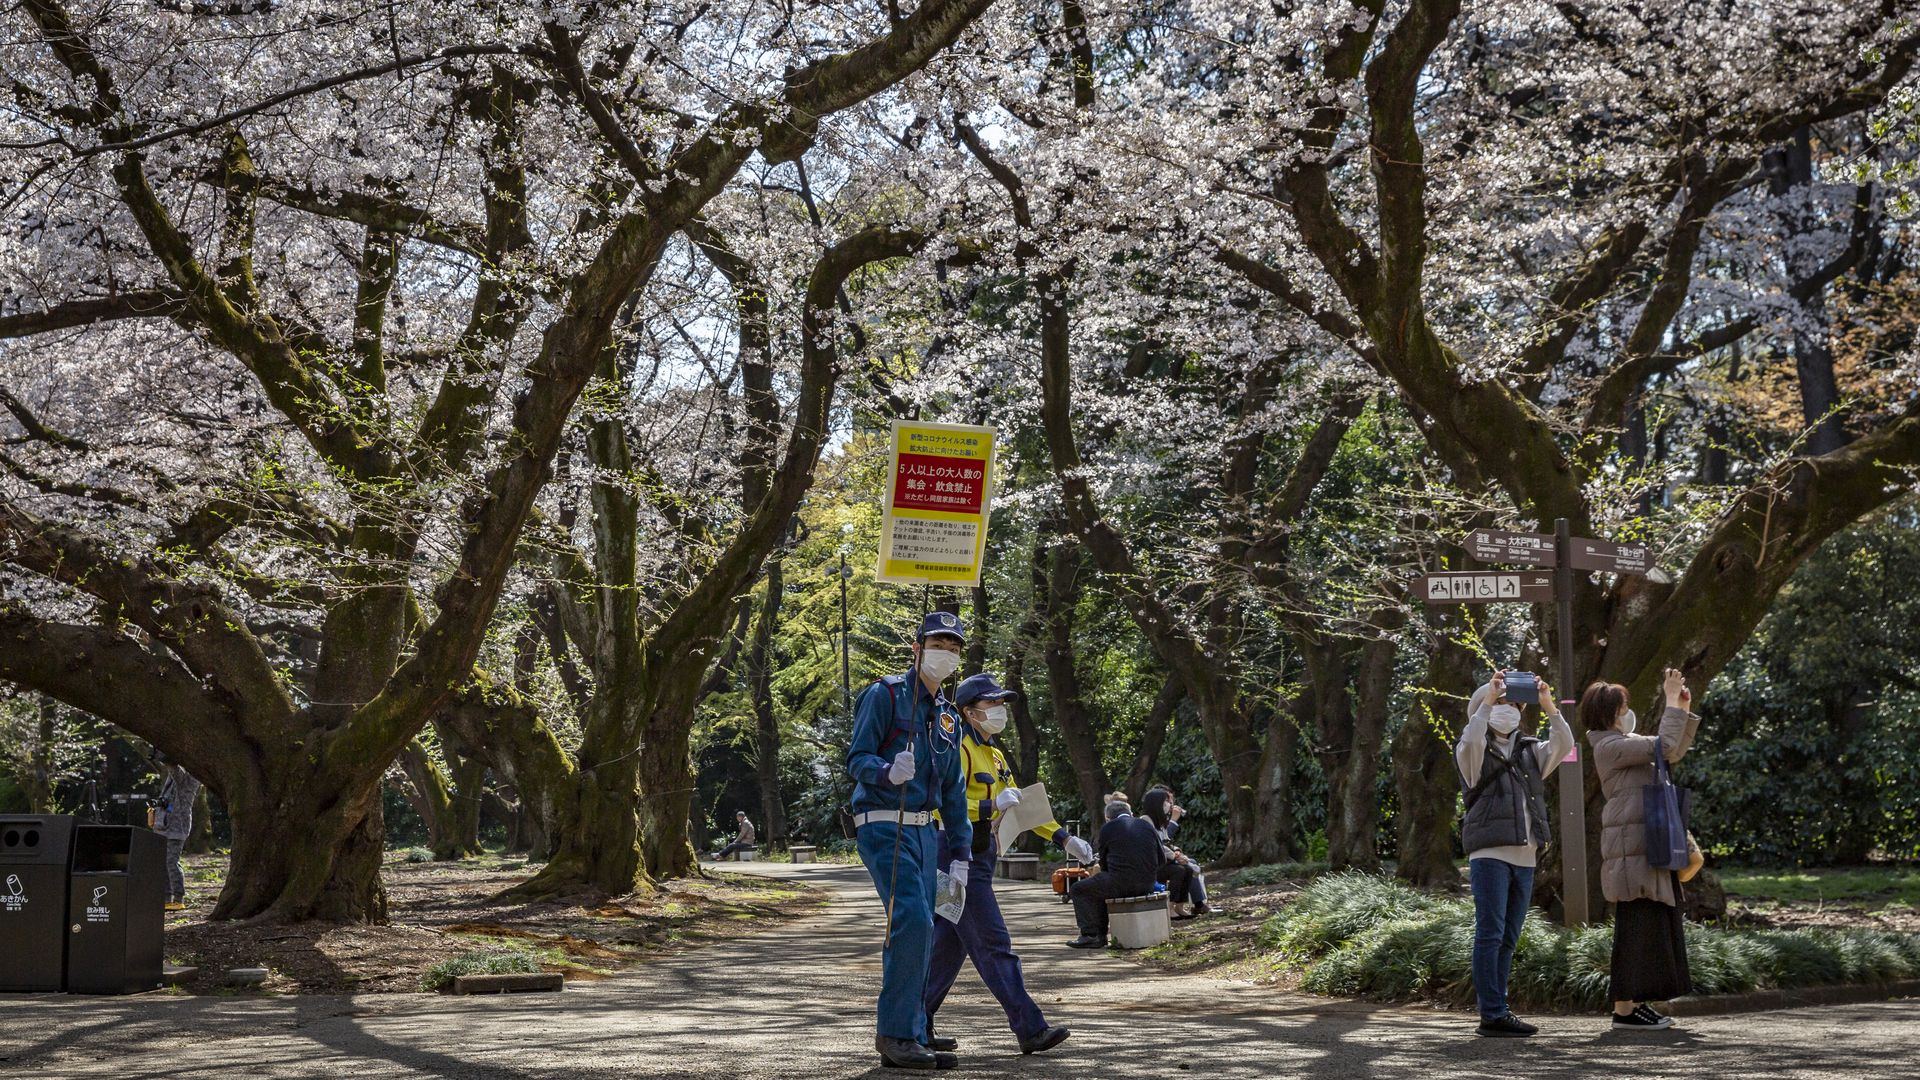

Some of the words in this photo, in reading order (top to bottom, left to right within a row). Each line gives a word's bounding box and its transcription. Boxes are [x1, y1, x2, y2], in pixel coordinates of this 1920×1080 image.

[906, 479, 973, 494] 集会・飲食禁止
[0, 895, 29, 903] あきかん
